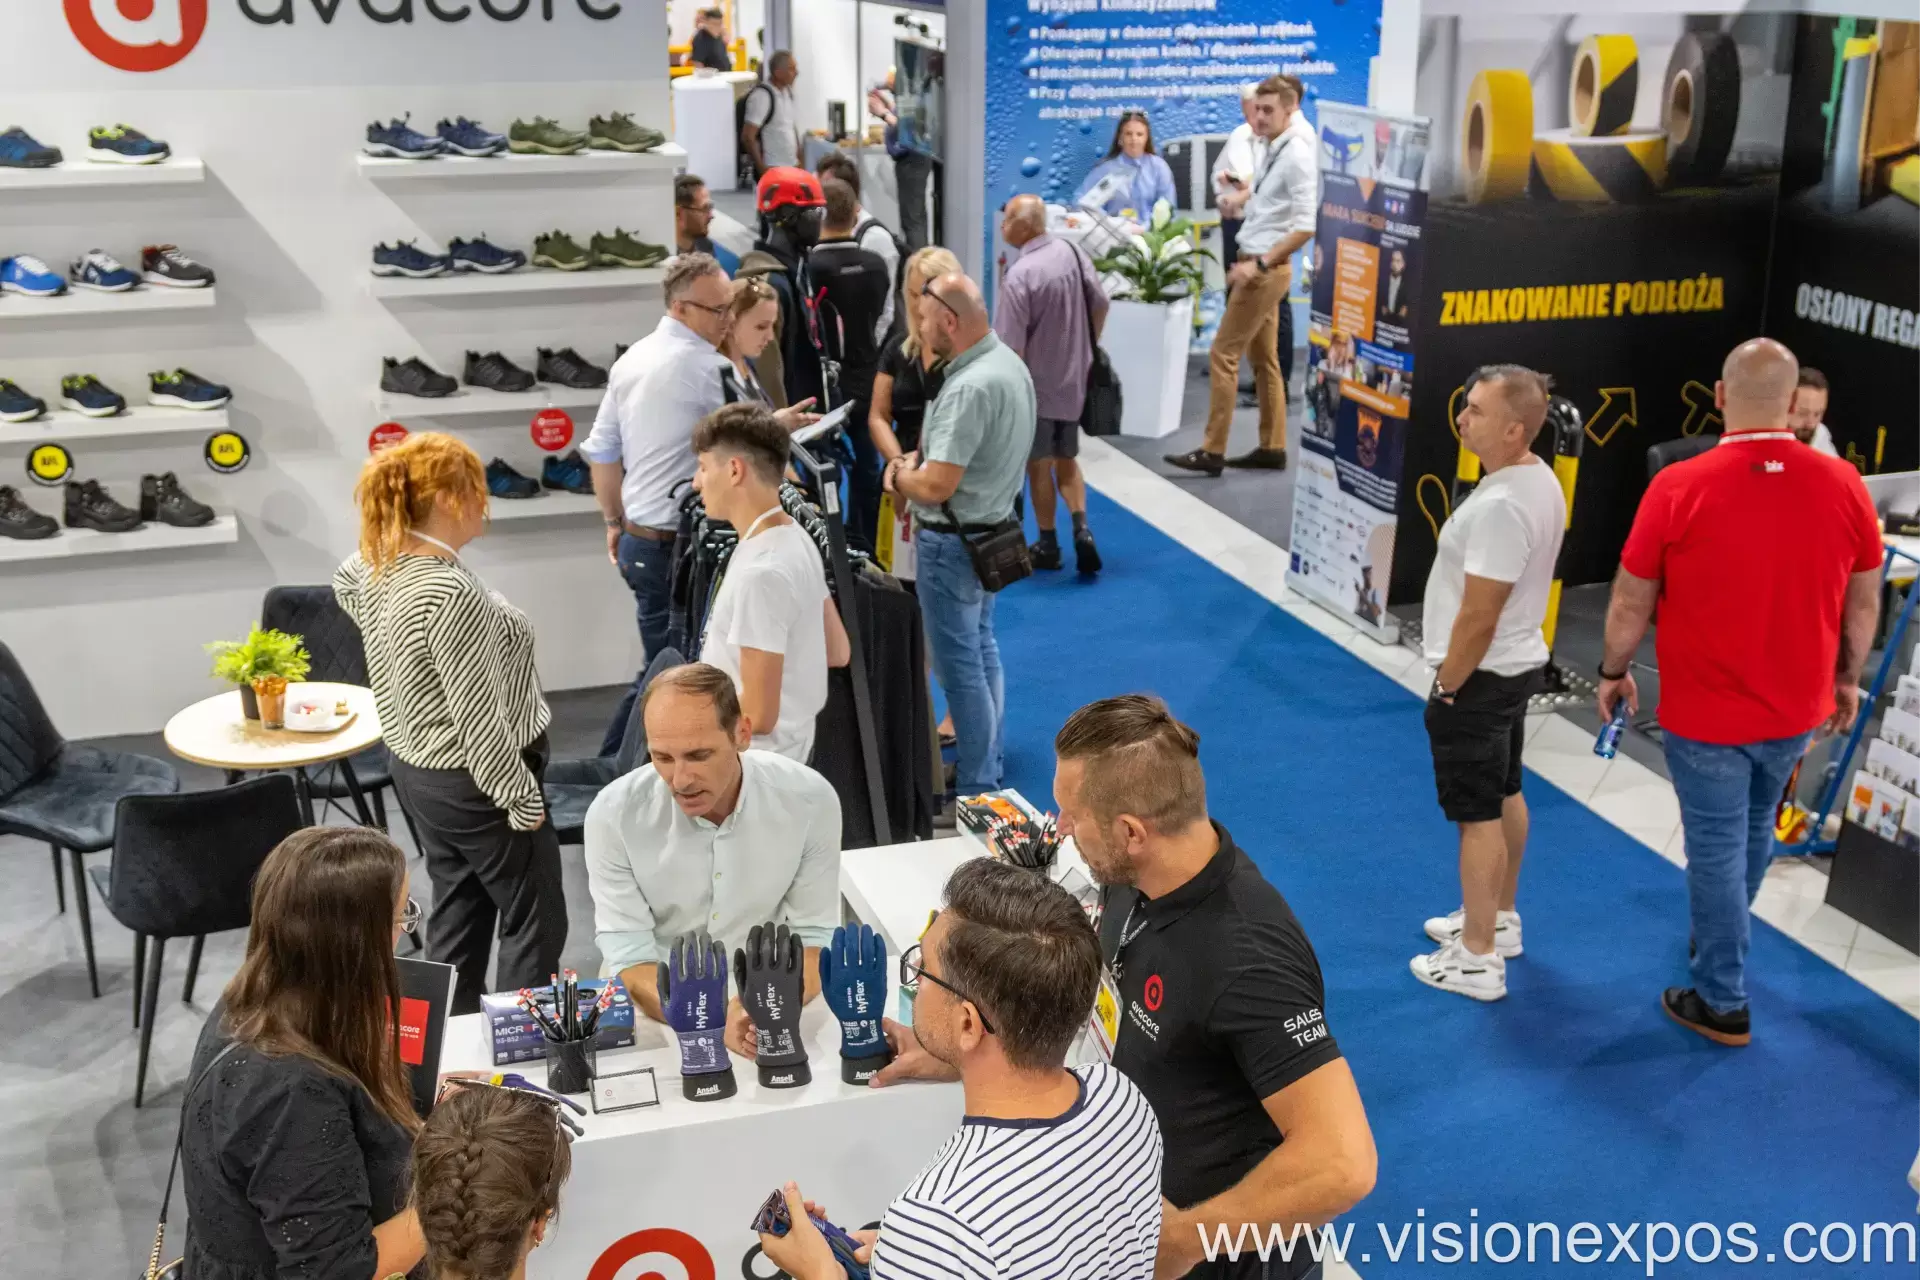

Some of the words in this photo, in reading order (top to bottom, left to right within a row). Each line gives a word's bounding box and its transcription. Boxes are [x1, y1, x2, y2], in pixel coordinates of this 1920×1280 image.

[1439, 282, 1611, 326] ZNAKOWANIE
[1613, 272, 1725, 317] PODŁOŻA
[1795, 282, 1874, 334] OSŁONY
[696, 993, 708, 1029] HyFlex
[767, 984, 781, 1020] HyFlex
[856, 981, 868, 1014] HyFlex
[495, 1023, 543, 1036] MICROF
[1131, 1000, 1160, 1035] avacore
[1283, 1008, 1322, 1034] SALES
[1292, 1023, 1328, 1047] TEAM
[696, 1084, 719, 1096] Ansell
[771, 1074, 794, 1084] Ansell
